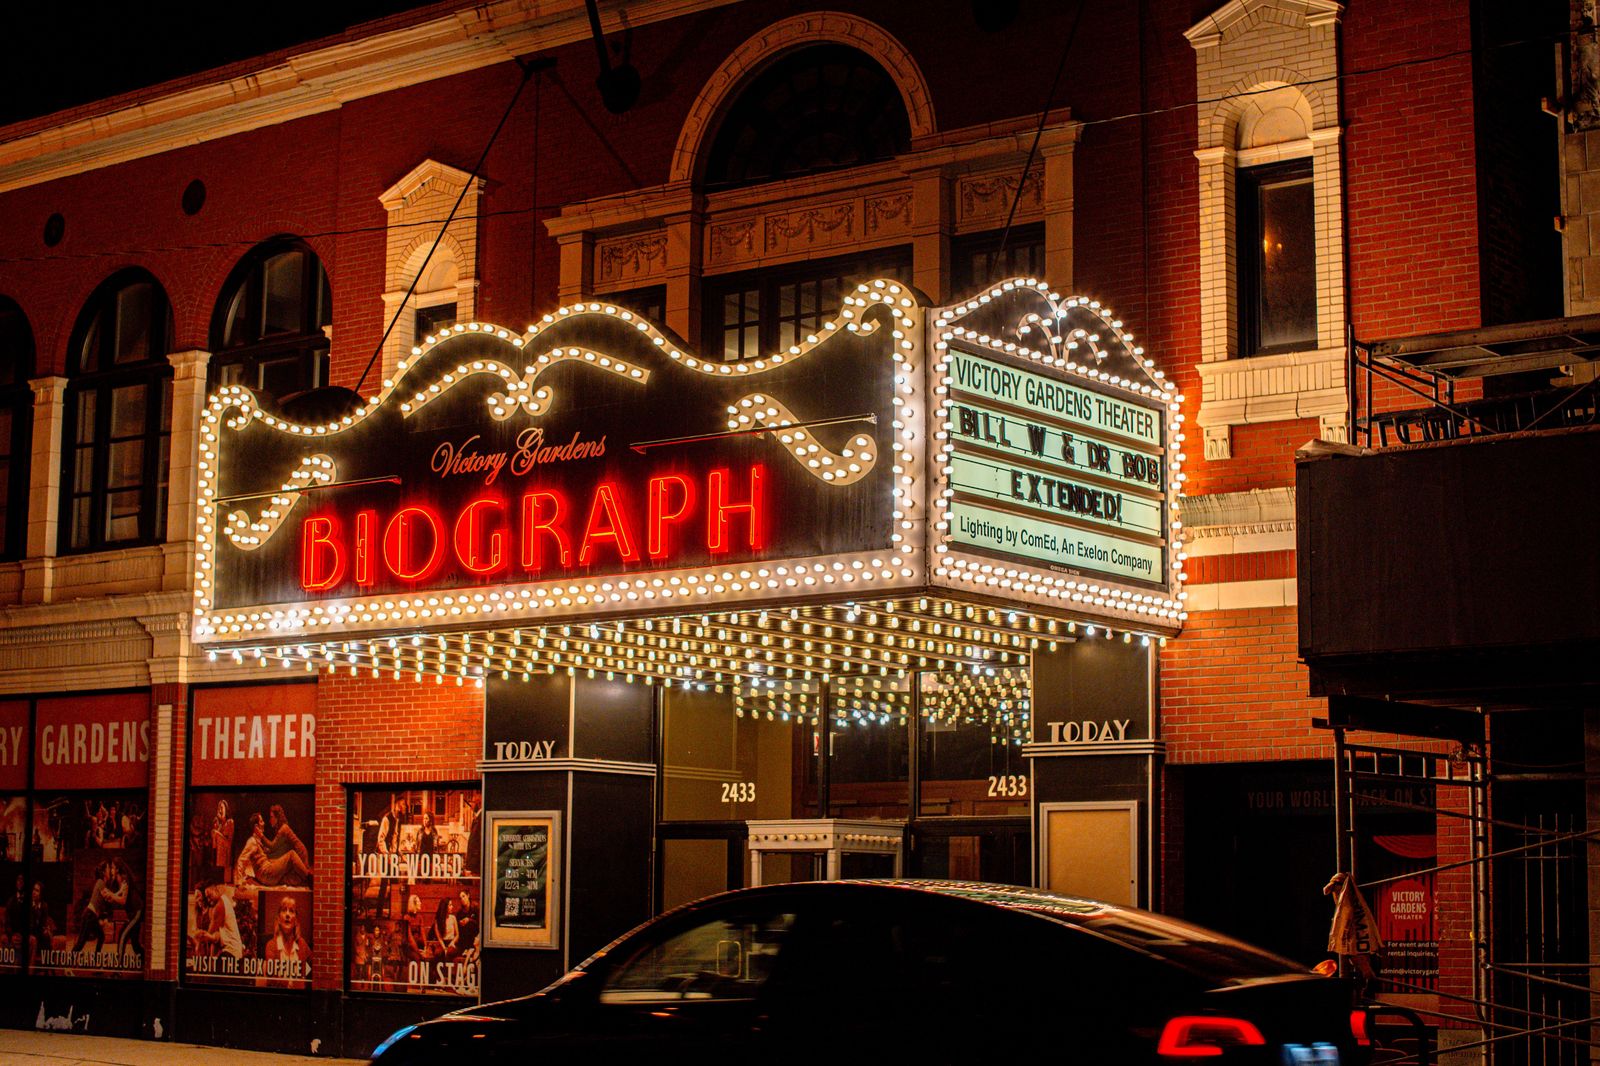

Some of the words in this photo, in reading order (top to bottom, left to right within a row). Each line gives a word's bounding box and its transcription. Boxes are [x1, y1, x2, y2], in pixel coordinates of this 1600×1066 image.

[955, 356, 1022, 401] VICTORY
[1025, 378, 1092, 421] GARDENS
[1095, 398, 1154, 439] THEATER
[431, 434, 508, 486] Victory
[511, 427, 607, 476] Gardens
[958, 406, 1012, 448] BILL
[1026, 423, 1047, 457] W
[1087, 440, 1111, 474] DR
[1122, 452, 1160, 484] BOB
[1010, 468, 1123, 523] EXTENDED!
[302, 463, 766, 590] BIOGRAPH
[960, 516, 1003, 543] Lighting
[1005, 524, 1018, 547] by
[1020, 529, 1060, 555] ComEd,
[1061, 541, 1075, 556] An
[1077, 542, 1109, 563] Exelon
[1111, 549, 1153, 574] Company
[41, 720, 150, 766] GARDENS
[198, 713, 317, 760] THEATER
[1047, 719, 1130, 743] TODAY
[494, 740, 555, 760] TODAY
[721, 782, 756, 803] 2433
[987, 775, 1027, 797] 2433
[1247, 790, 1284, 809] YOUR
[358, 853, 400, 877] YOUR
[406, 853, 462, 878] WORLD
[1390, 902, 1427, 913] GARDENS
[1392, 891, 1425, 902] VICTORY
[41, 949, 142, 969] VICTORYGARDENS.ORG
[192, 956, 218, 972] VISIT
[222, 957, 240, 973] THE
[243, 958, 264, 975] BOX
[267, 959, 302, 977] OFFICE
[408, 960, 430, 985] ON
